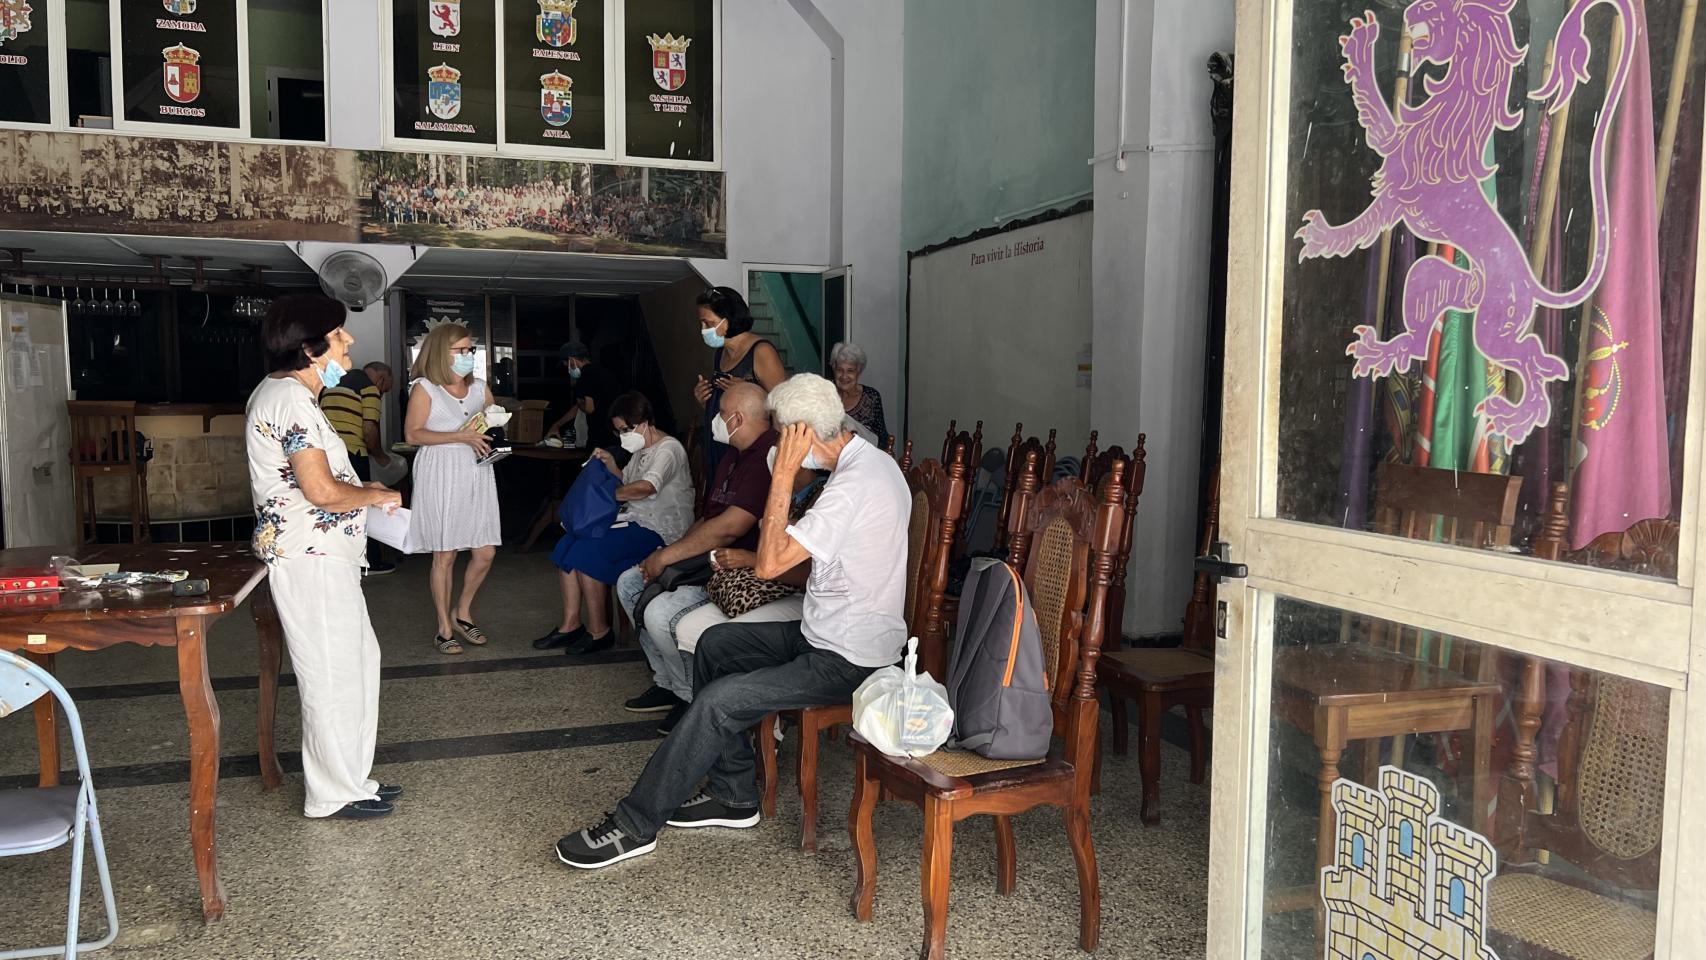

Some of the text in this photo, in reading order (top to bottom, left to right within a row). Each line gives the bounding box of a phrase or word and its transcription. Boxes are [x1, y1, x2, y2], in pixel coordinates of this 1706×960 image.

[156, 19, 206, 32] ZAMORA
[433, 42, 460, 52] LEON
[532, 48, 580, 61] PALENCIA
[648, 94, 692, 105] CASTILLA
[159, 105, 206, 117] BURGOS
[653, 103, 661, 112] Y
[414, 121, 476, 133] SALAMANCA
[542, 129, 571, 139] AVILA
[971, 237, 1044, 266] Para vivir la Historia
